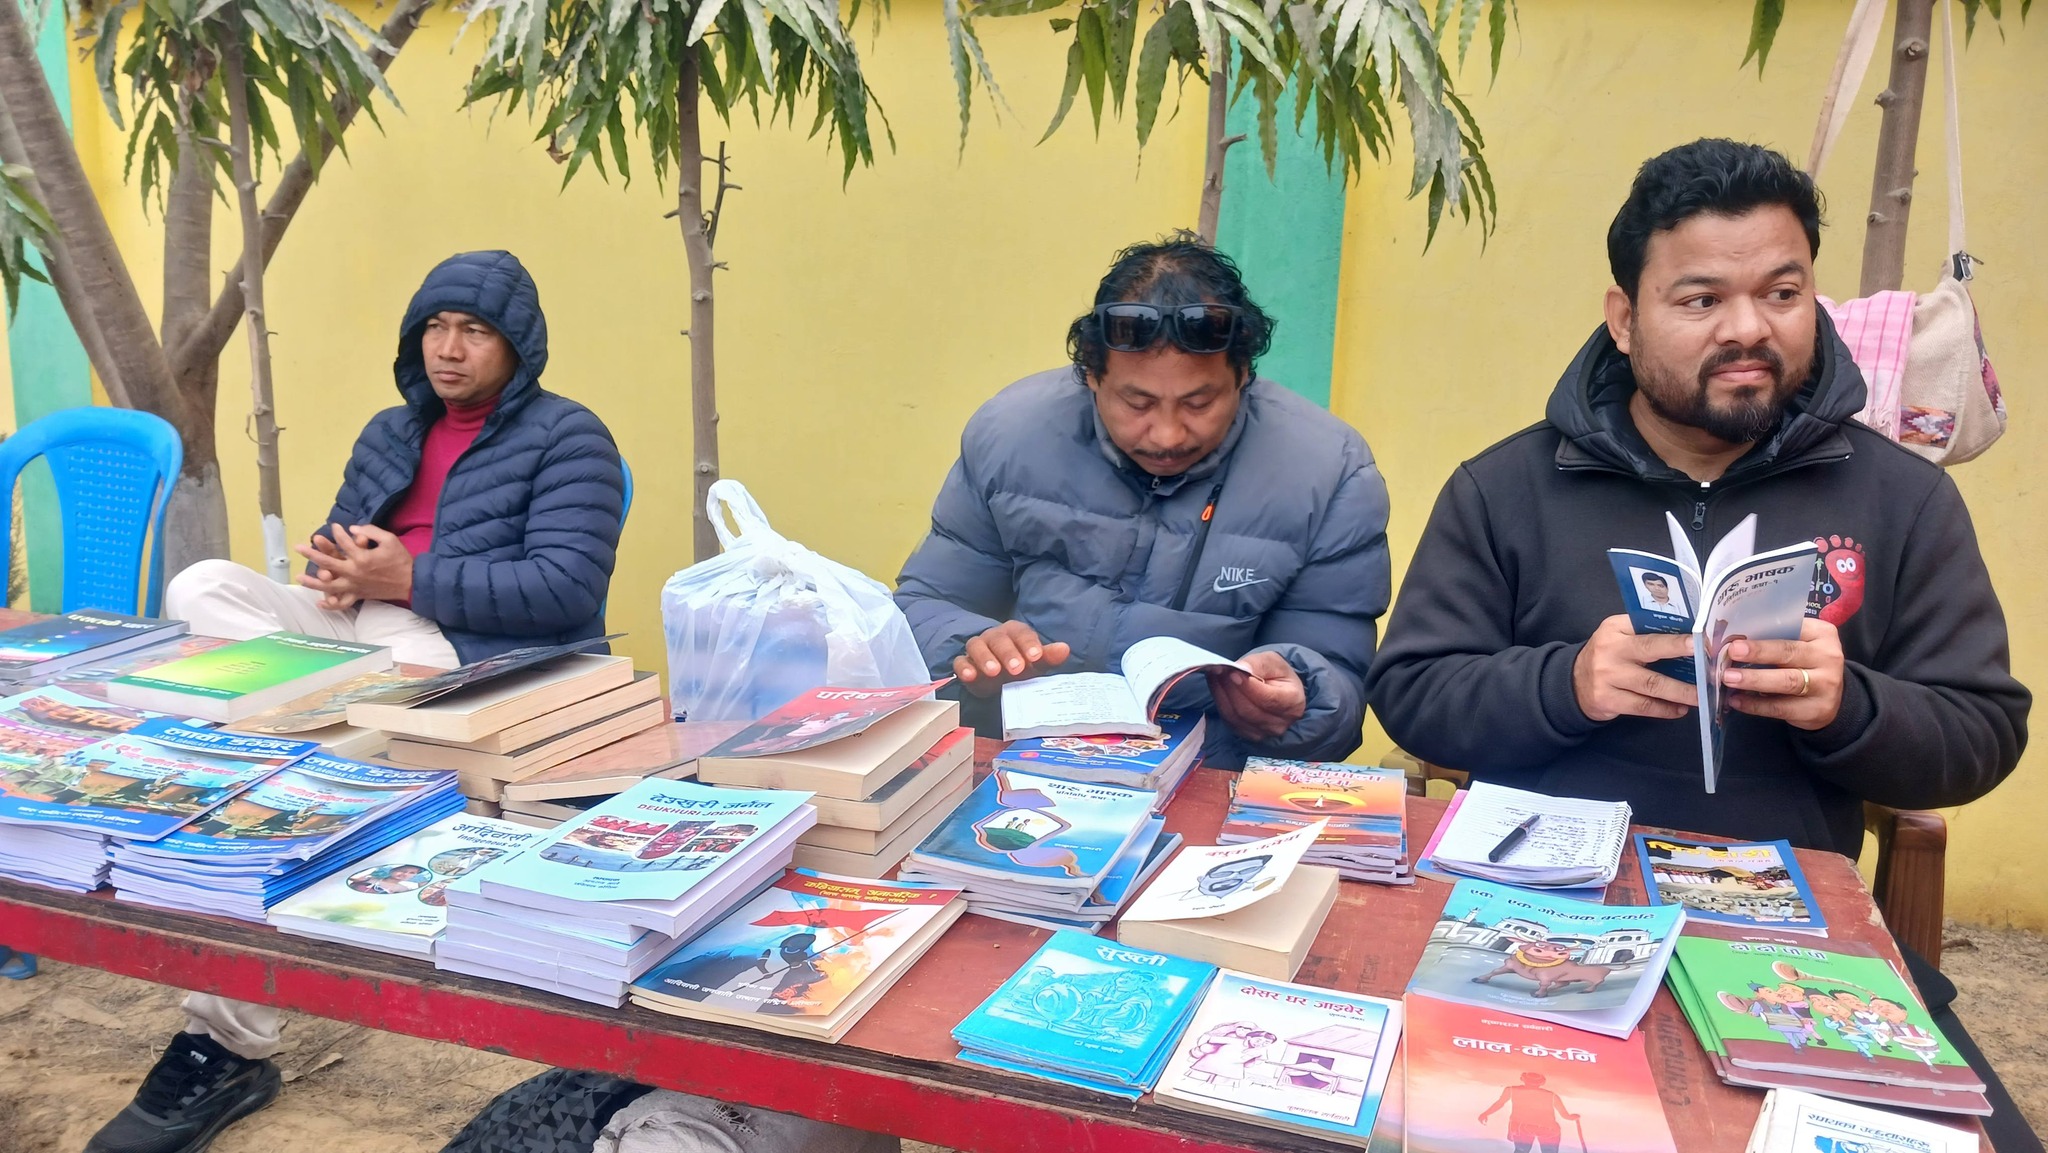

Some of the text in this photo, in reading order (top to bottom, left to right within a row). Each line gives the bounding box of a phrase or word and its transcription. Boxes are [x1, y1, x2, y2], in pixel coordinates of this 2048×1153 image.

[1220, 566, 1255, 582] NIKE
[1744, 564, 1796, 583] भाषक
[649, 793, 775, 809] देउखुरी जर्नल
[637, 803, 759, 816] DEUKHURI JOURNAL
[452, 823, 534, 842] आदिवासी
[457, 833, 508, 847] Indigenous
[1240, 985, 1367, 1016] दोसर घर जाइबेर
